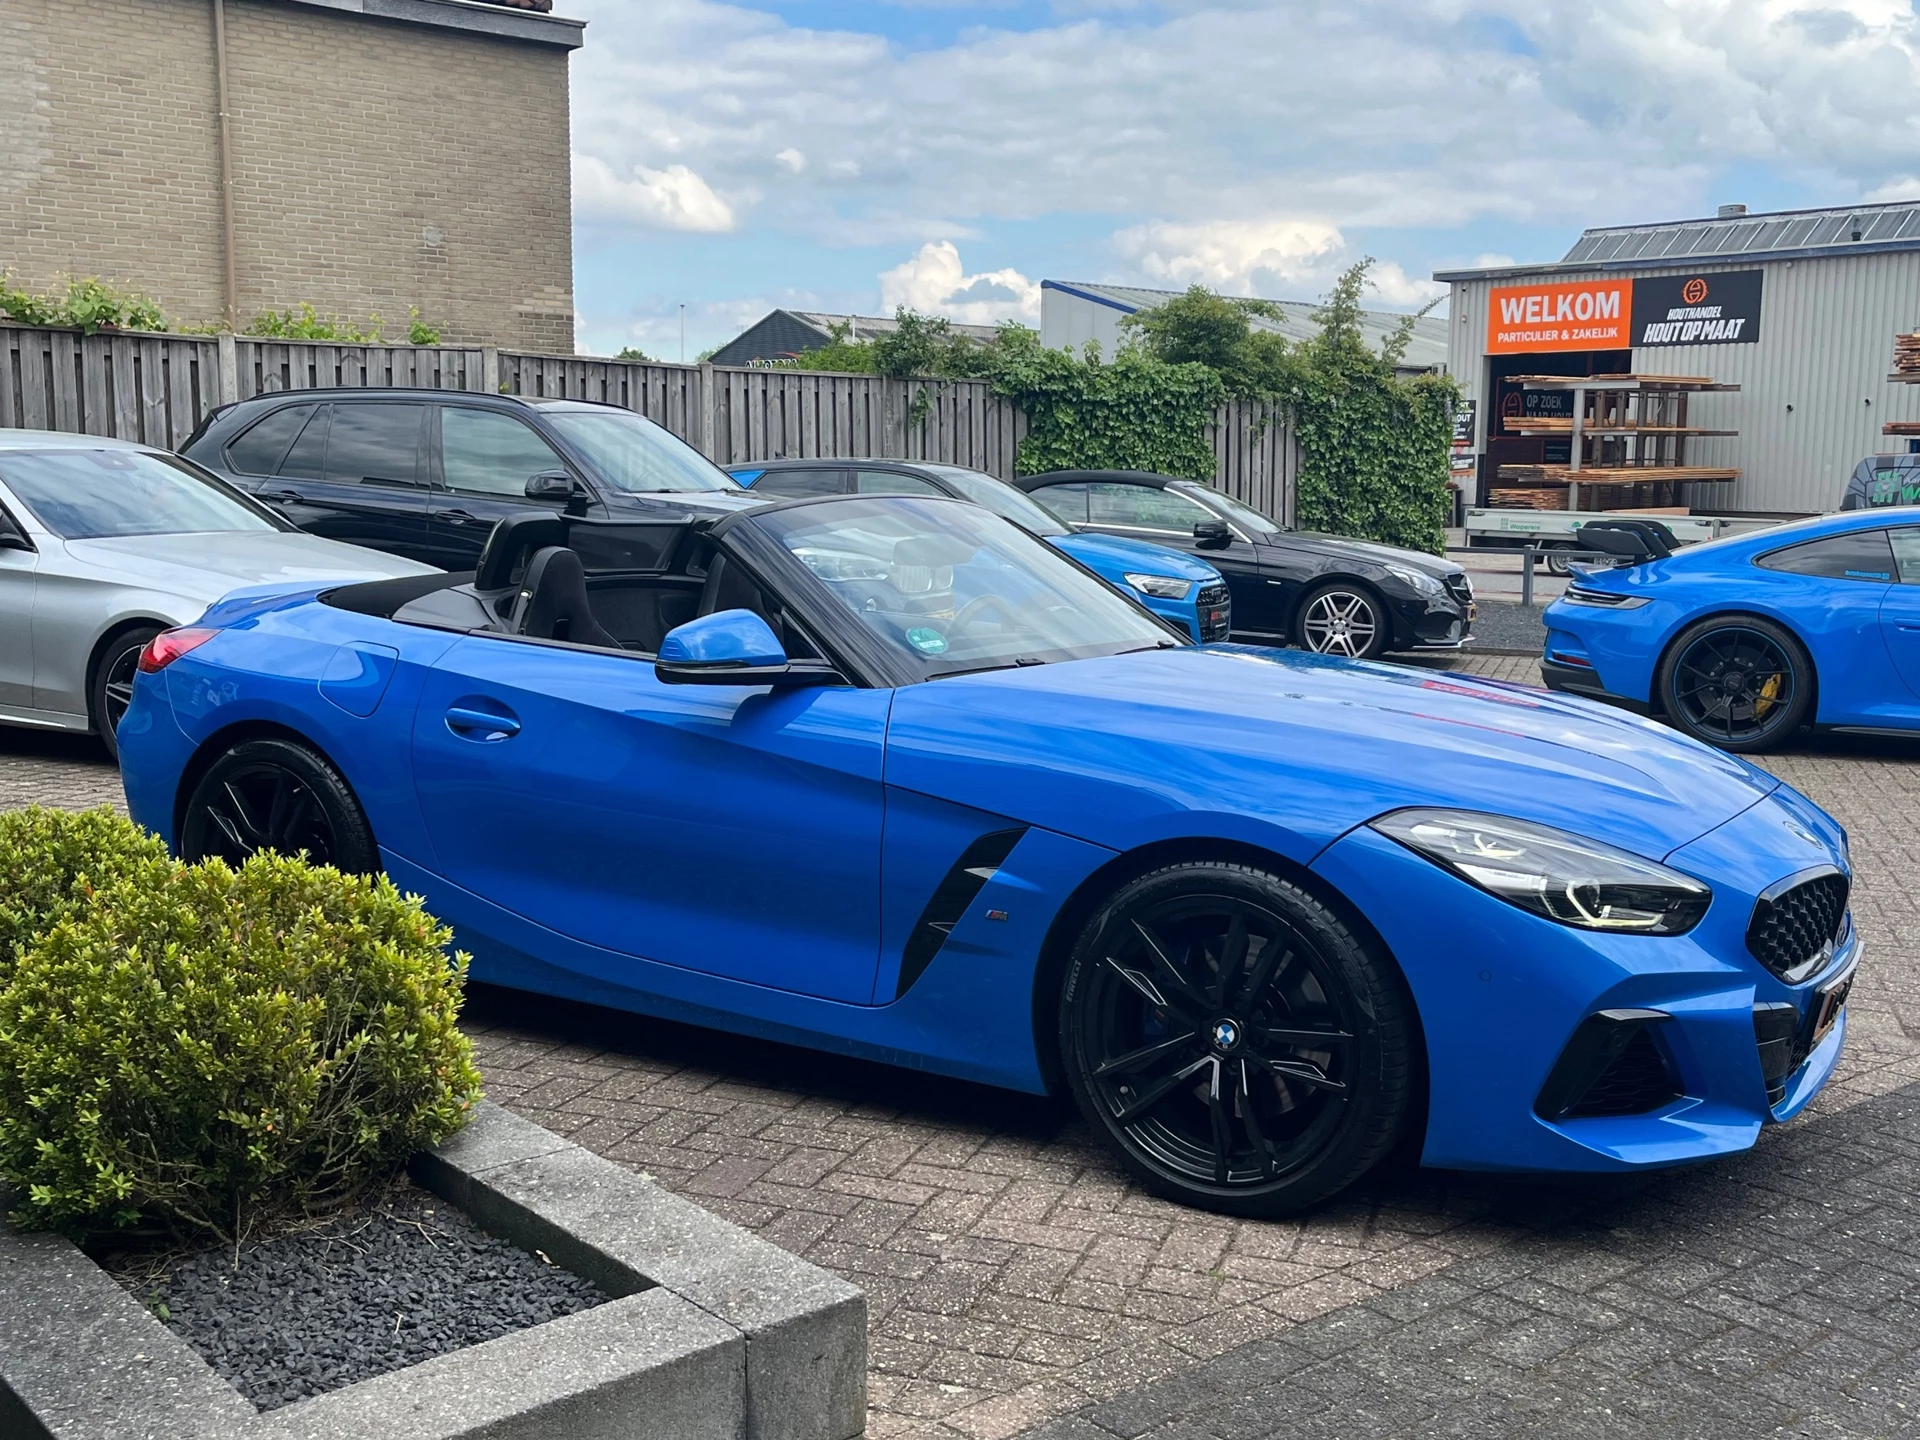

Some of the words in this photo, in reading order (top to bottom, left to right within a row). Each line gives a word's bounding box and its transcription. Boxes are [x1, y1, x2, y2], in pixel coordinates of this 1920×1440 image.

[1500, 291, 1620, 325] WELKOM
[1666, 306, 1722, 320] HOUTHANDEL
[1497, 329, 1559, 343] PARTICULIER
[1560, 329, 1570, 340] &
[1571, 327, 1619, 340] ZAKELIJK
[1526, 394, 1539, 408] OP
[1540, 394, 1562, 409] ZOEK
